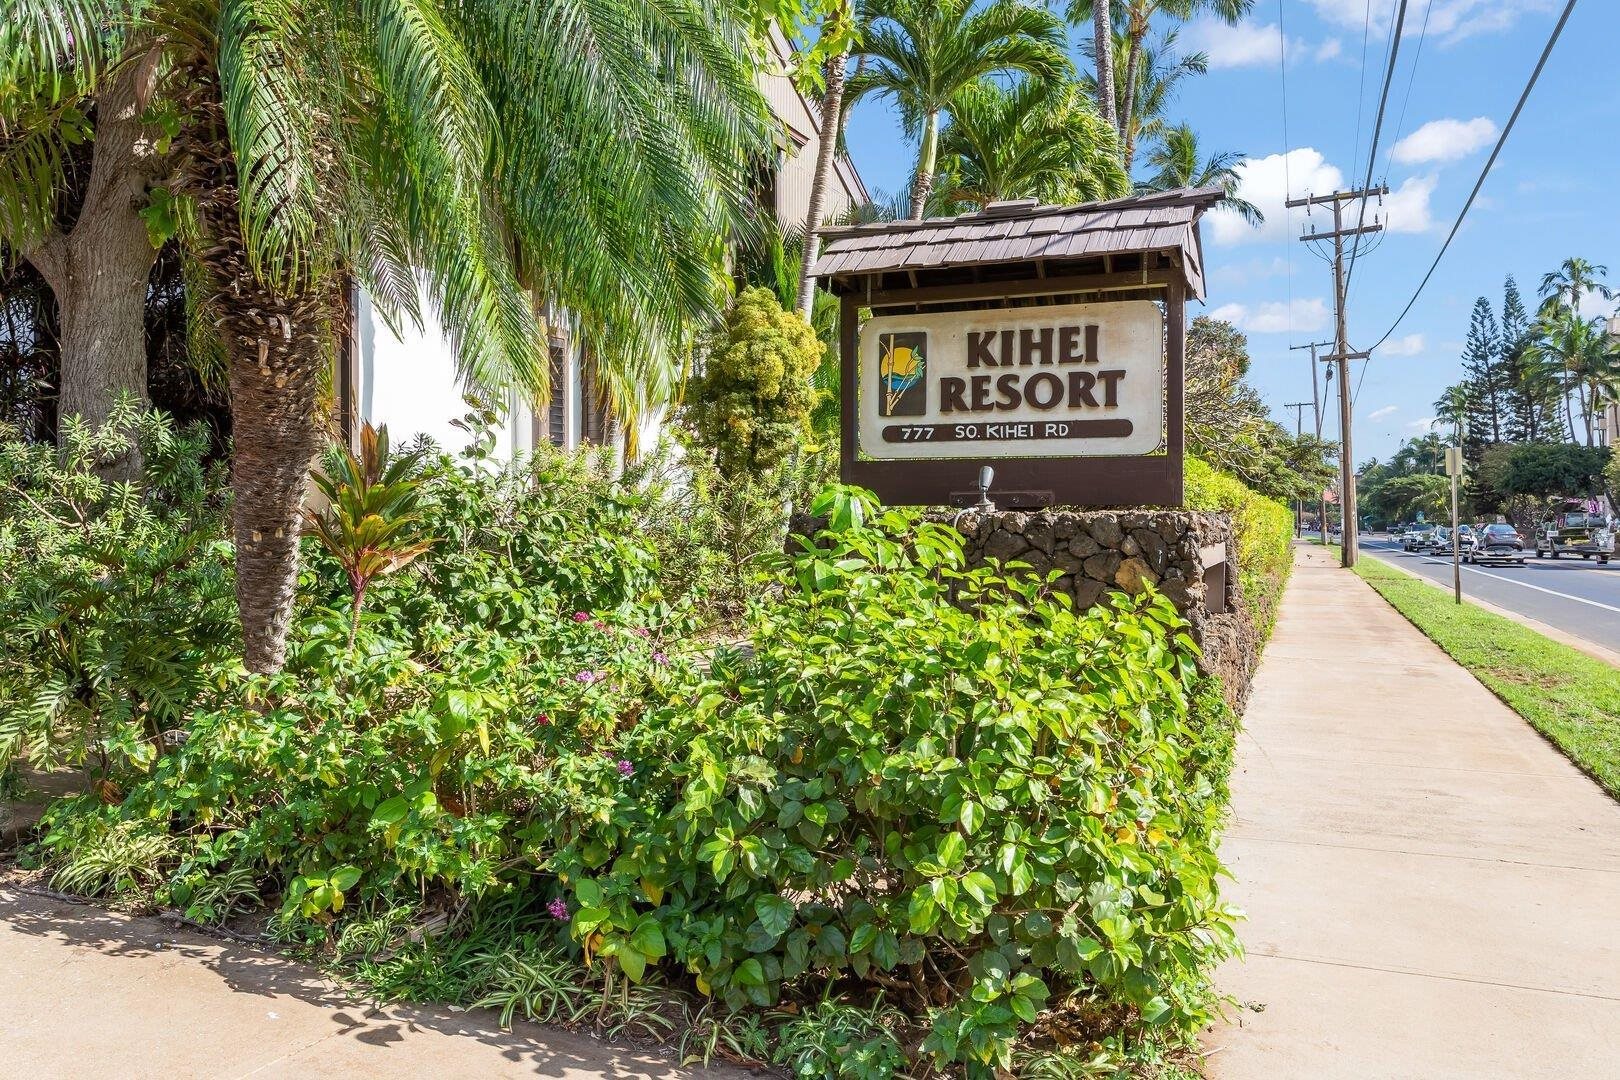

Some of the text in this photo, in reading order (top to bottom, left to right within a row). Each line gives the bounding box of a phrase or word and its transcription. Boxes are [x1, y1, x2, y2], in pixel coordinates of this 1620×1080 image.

[967, 325, 1099, 367] KIHEI
[940, 370, 1126, 412] RESORT
[901, 424, 1069, 440] 777 SO. KIHEI RD
